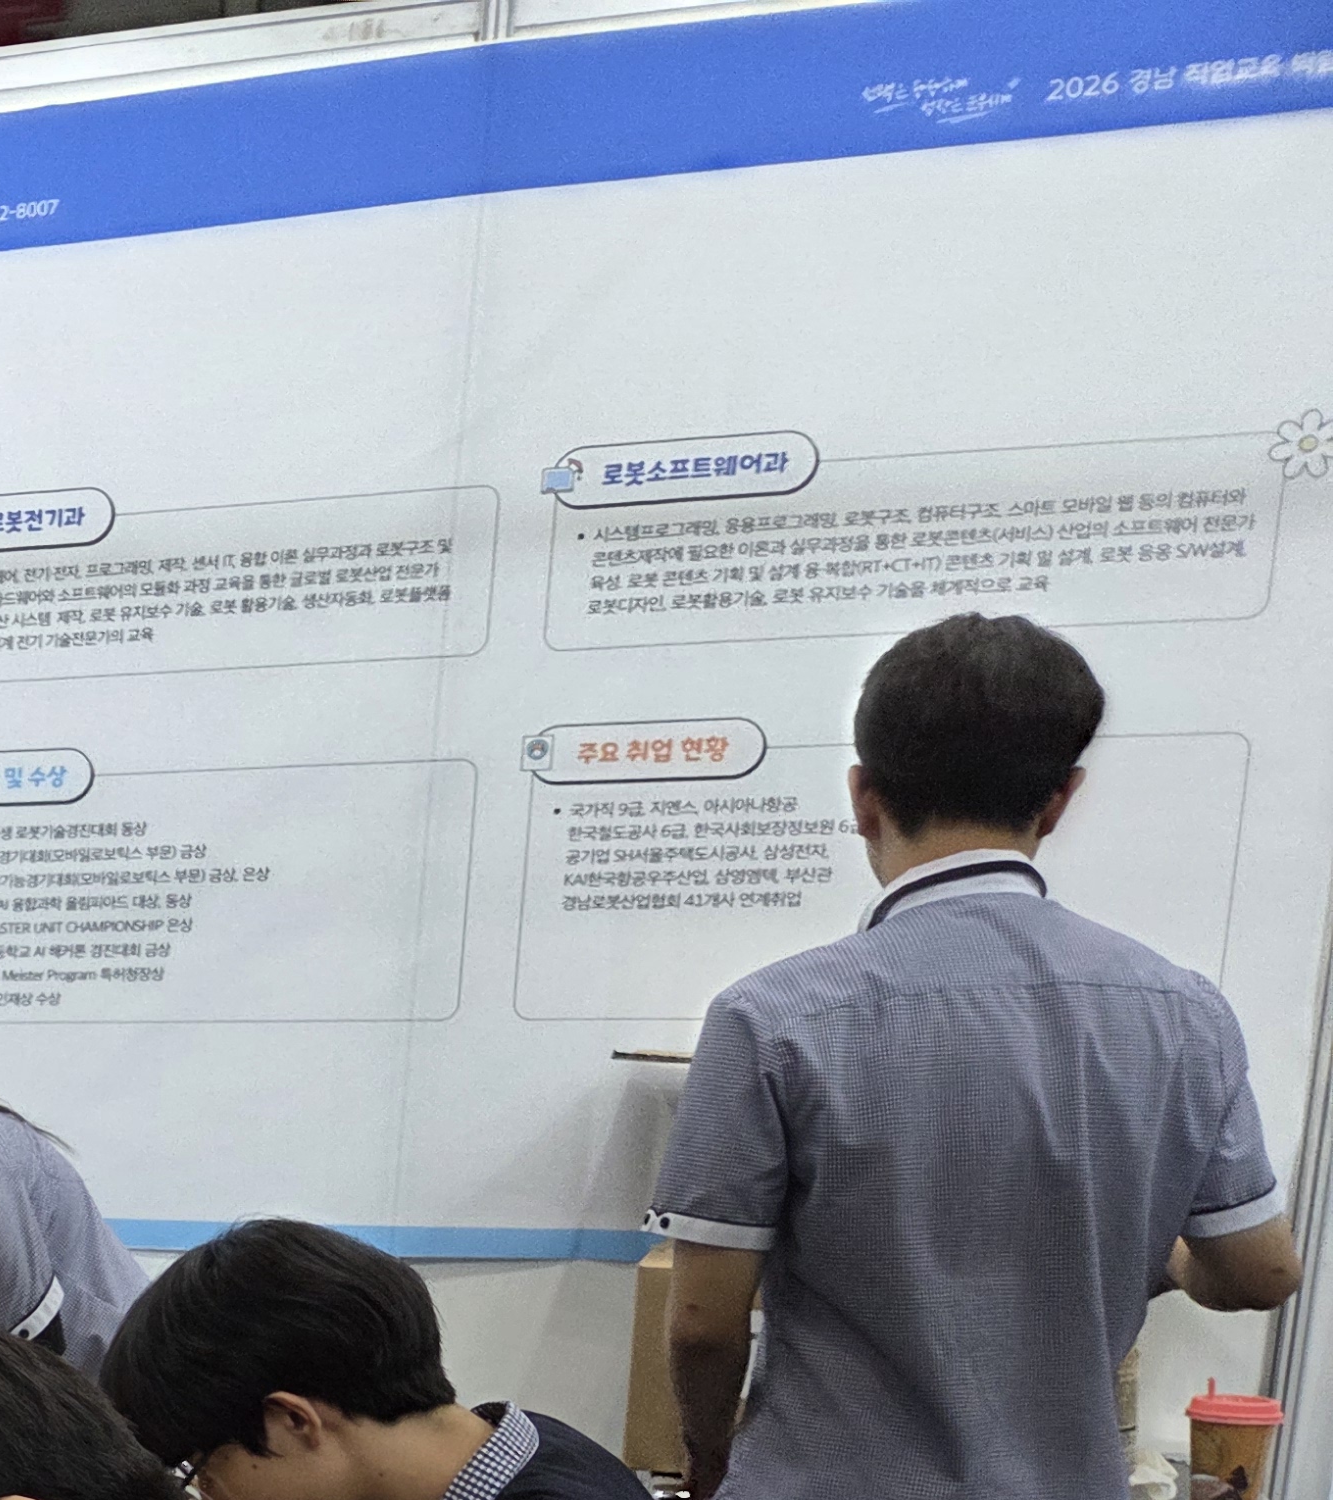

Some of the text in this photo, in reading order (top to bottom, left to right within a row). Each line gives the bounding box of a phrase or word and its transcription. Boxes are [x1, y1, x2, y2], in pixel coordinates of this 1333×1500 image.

[1046, 73, 1120, 102] 2026
[1129, 66, 1178, 95] 경남
[601, 451, 789, 487] 로봇소프트웨어과
[1007, 500, 1056, 517] 스마트
[1061, 496, 1112, 514] 모바일
[1057, 521, 1109, 540] 산업의
[577, 735, 730, 763] 주요 취업 현황
[4, 767, 23, 788] 및
[27, 765, 67, 788] 수상
[704, 797, 798, 814] 아시아나항공
[180, 844, 207, 859] 금상
[566, 849, 610, 865] 공기업
[243, 867, 270, 882] 은상
[34, 921, 63, 934] UNIT
[66, 919, 164, 933] CHAMPIONSHIP
[167, 917, 193, 933] 은상
[33, 946, 46, 957] AI
[145, 943, 171, 958] 금상
[2, 970, 44, 981] Meister
[47, 969, 97, 983] Program
